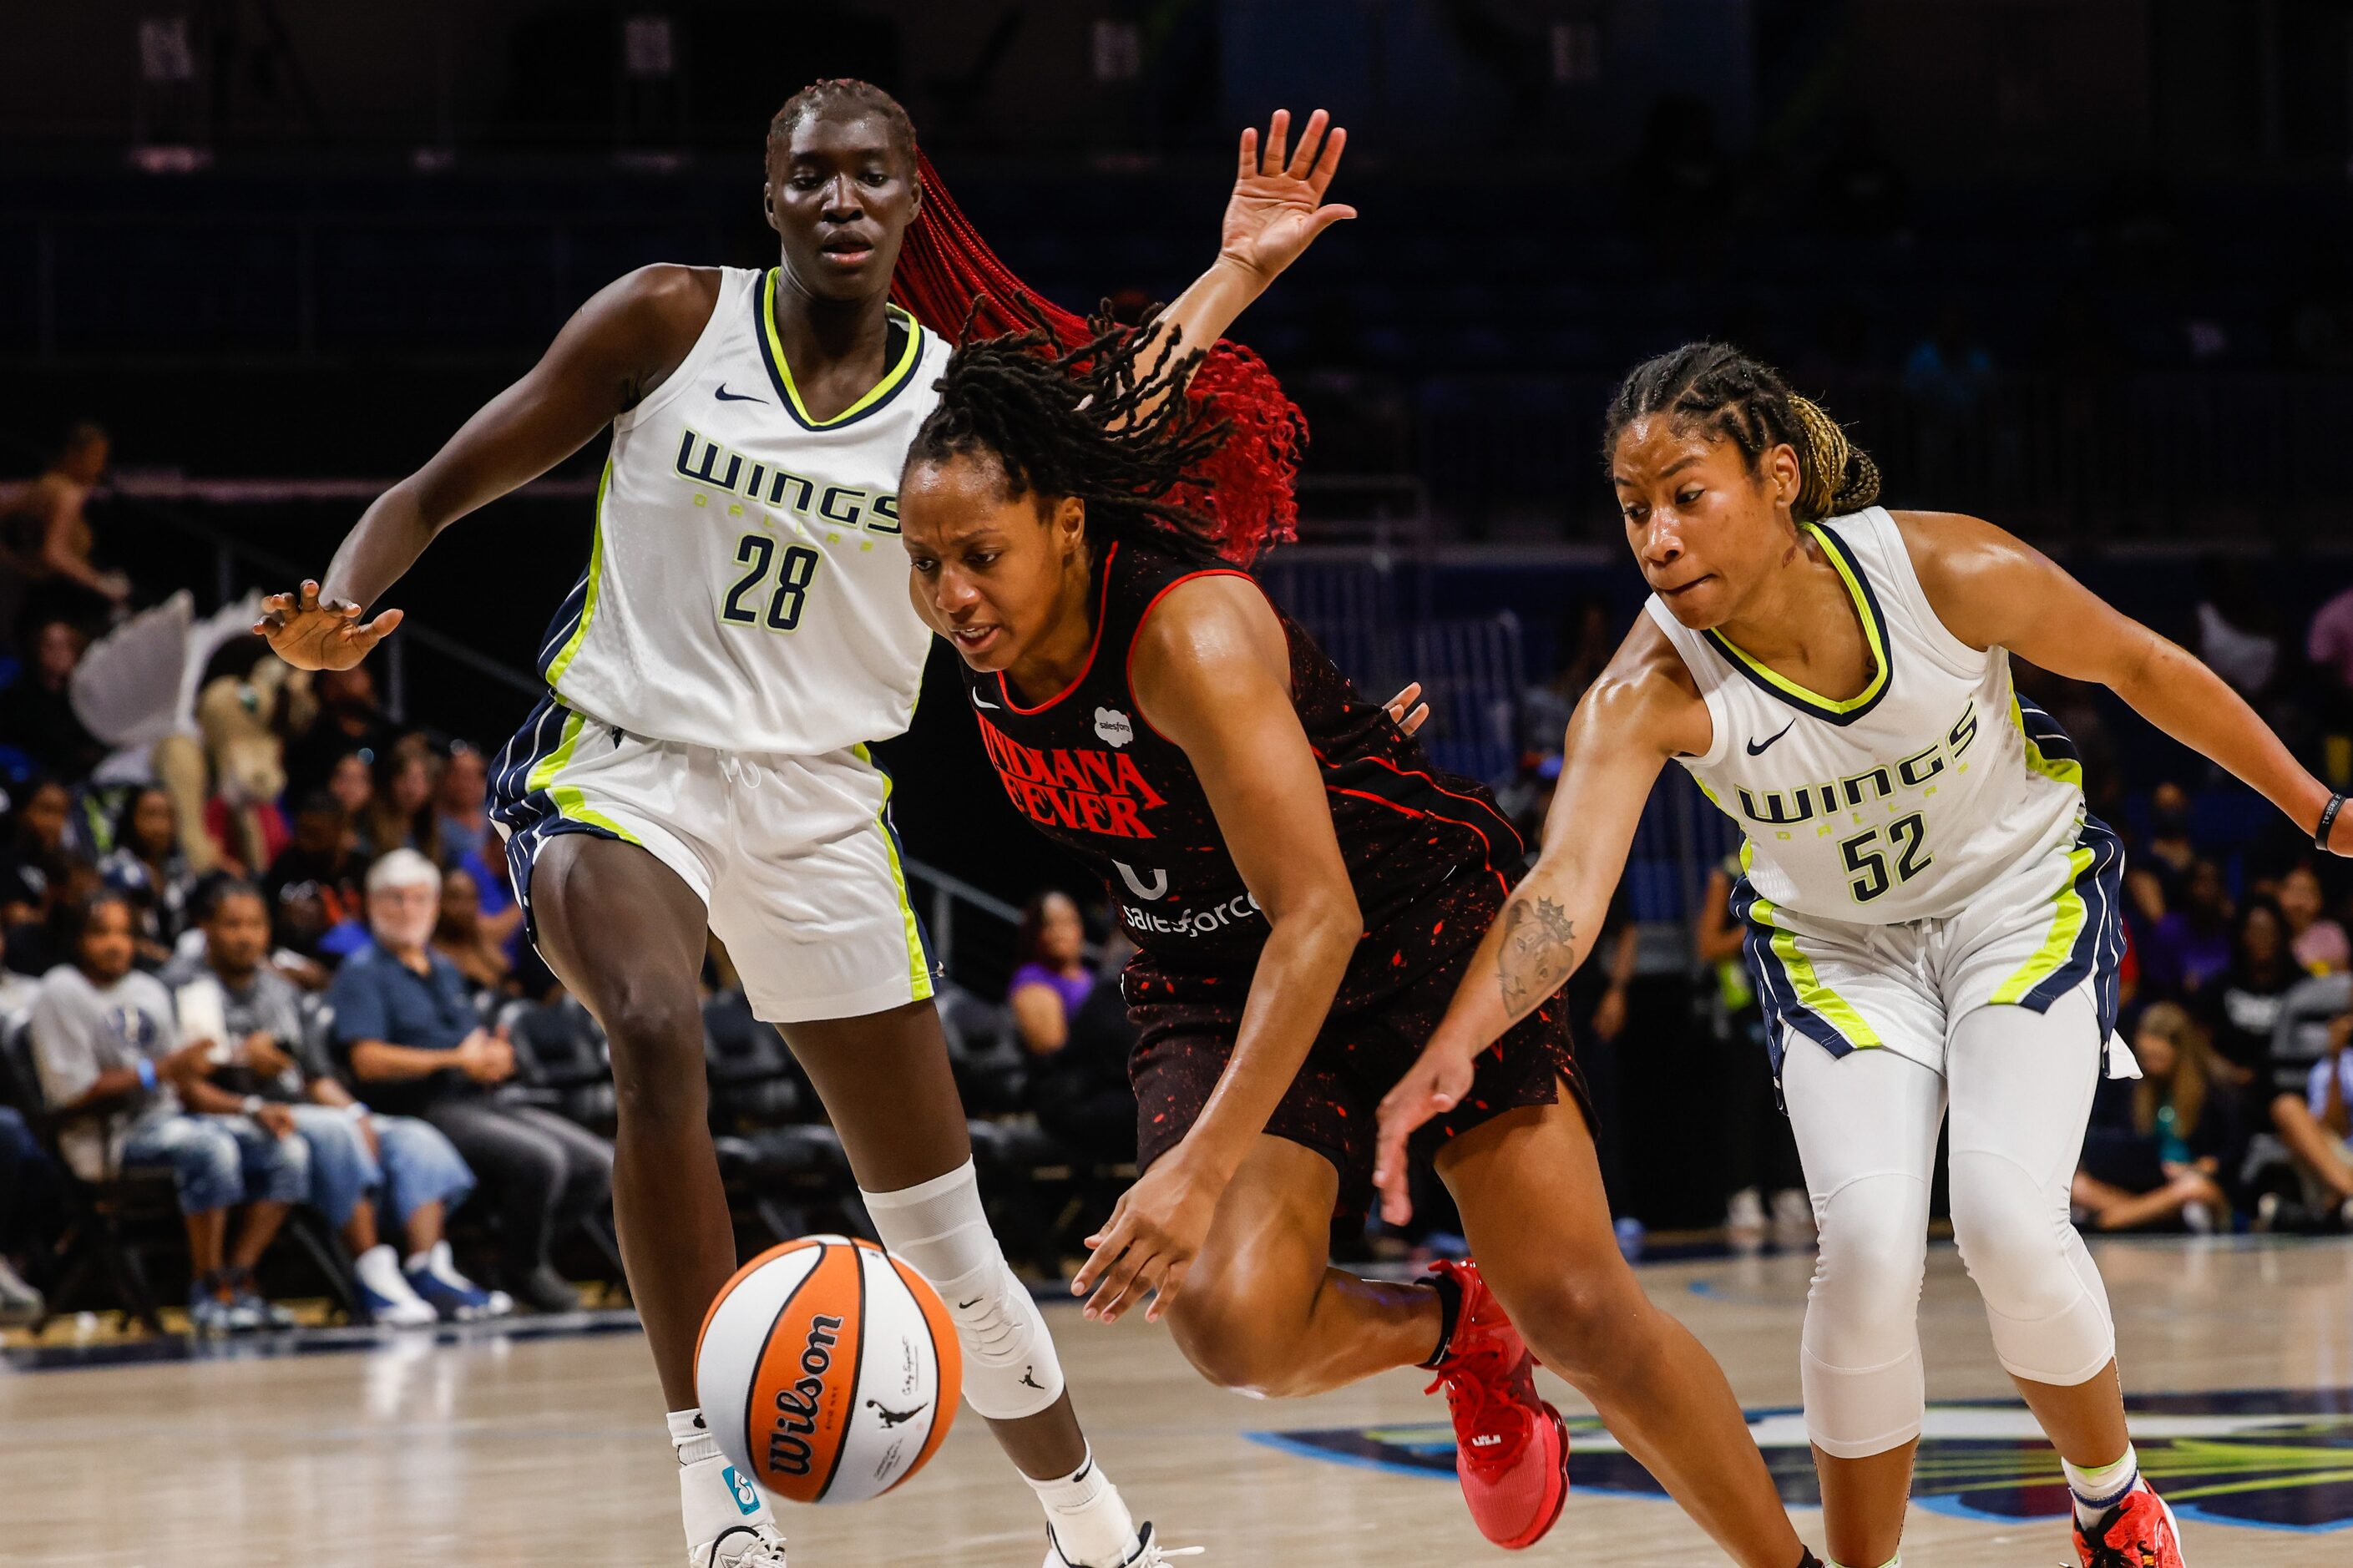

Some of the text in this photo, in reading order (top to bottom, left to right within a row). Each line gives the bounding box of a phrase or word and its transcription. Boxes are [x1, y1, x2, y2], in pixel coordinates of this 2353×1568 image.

[674, 427, 903, 536] WINGS
[720, 531, 823, 635] 28
[975, 710, 1167, 811] INDIANA
[996, 766, 1157, 838] FEVER
[1733, 695, 1979, 827] WINGS
[1838, 810, 1936, 906] 52
[767, 1313, 844, 1477] Wilson
